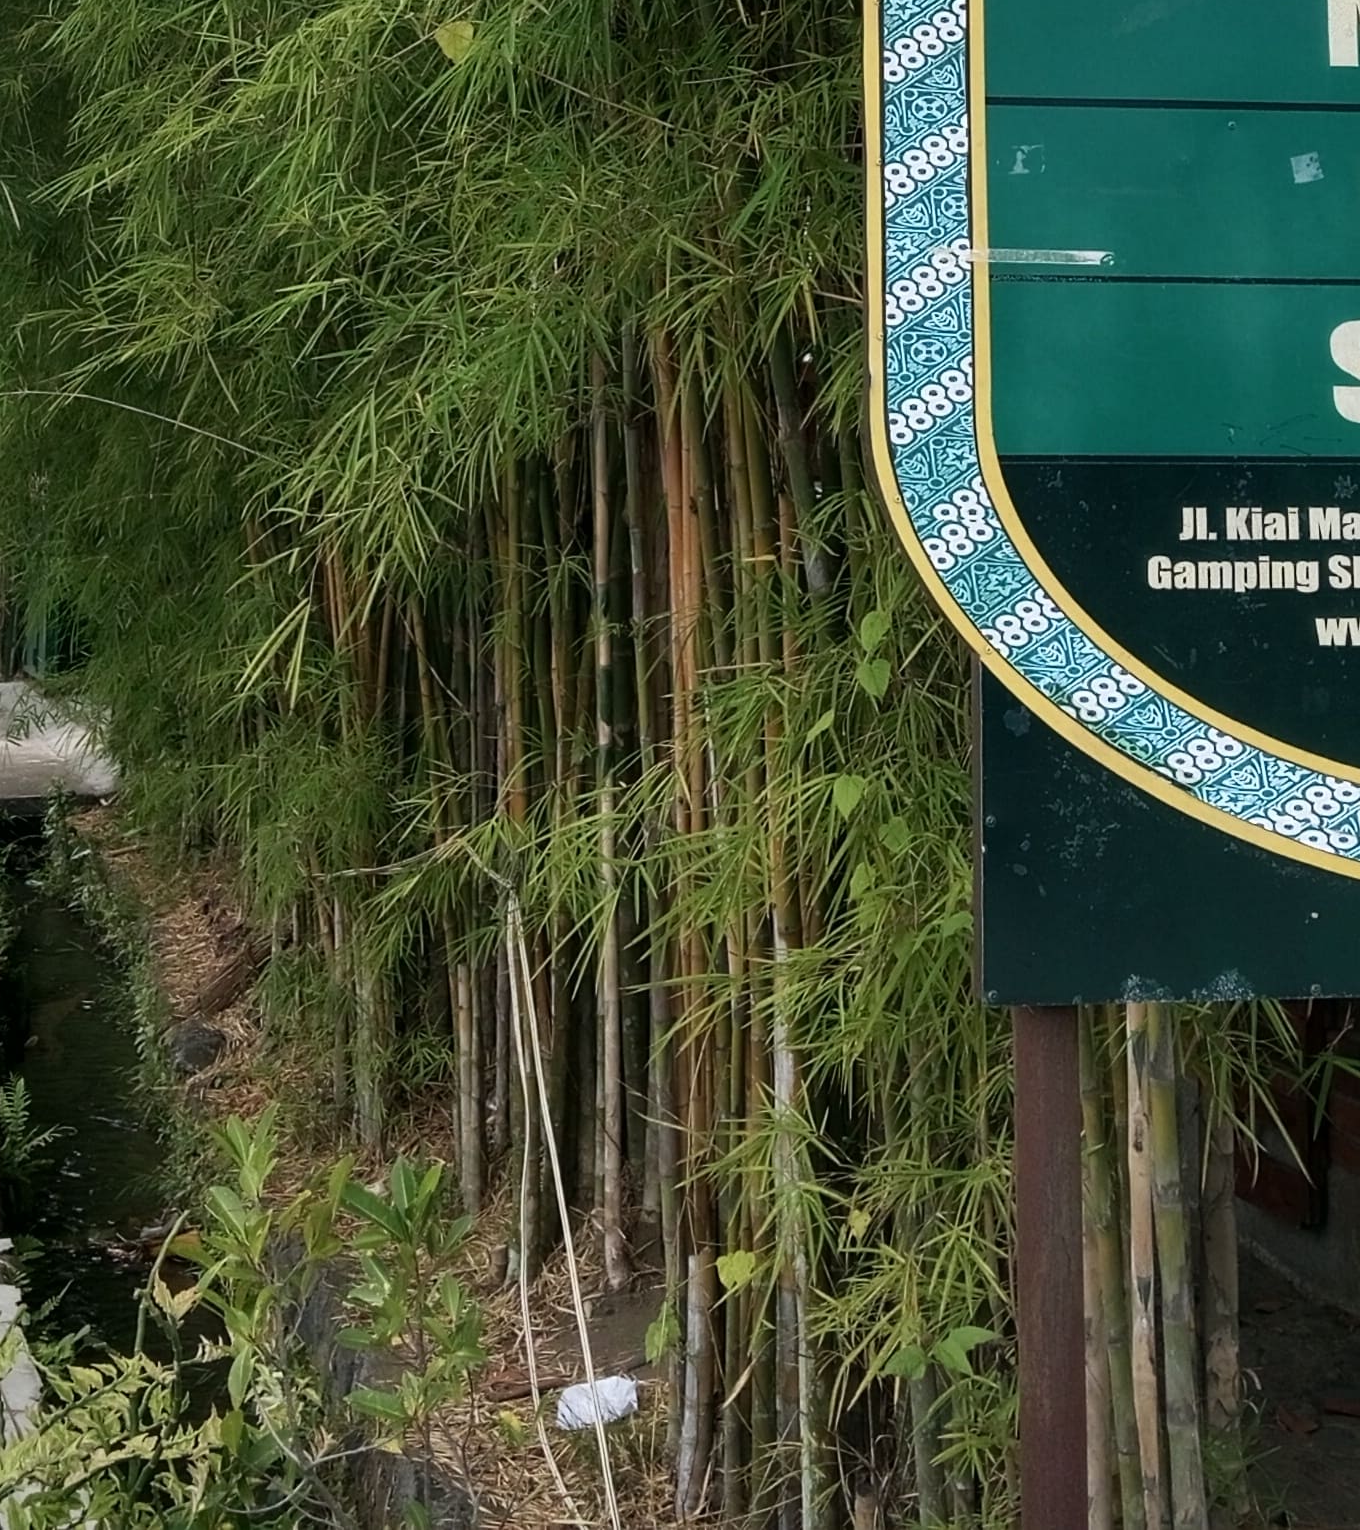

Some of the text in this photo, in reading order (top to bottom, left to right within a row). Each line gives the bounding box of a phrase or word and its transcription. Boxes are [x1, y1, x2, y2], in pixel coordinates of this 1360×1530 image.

[1179, 507, 1217, 541] Jl.
[1225, 506, 1300, 541] Kiai
[1147, 555, 1320, 593] Gamping
